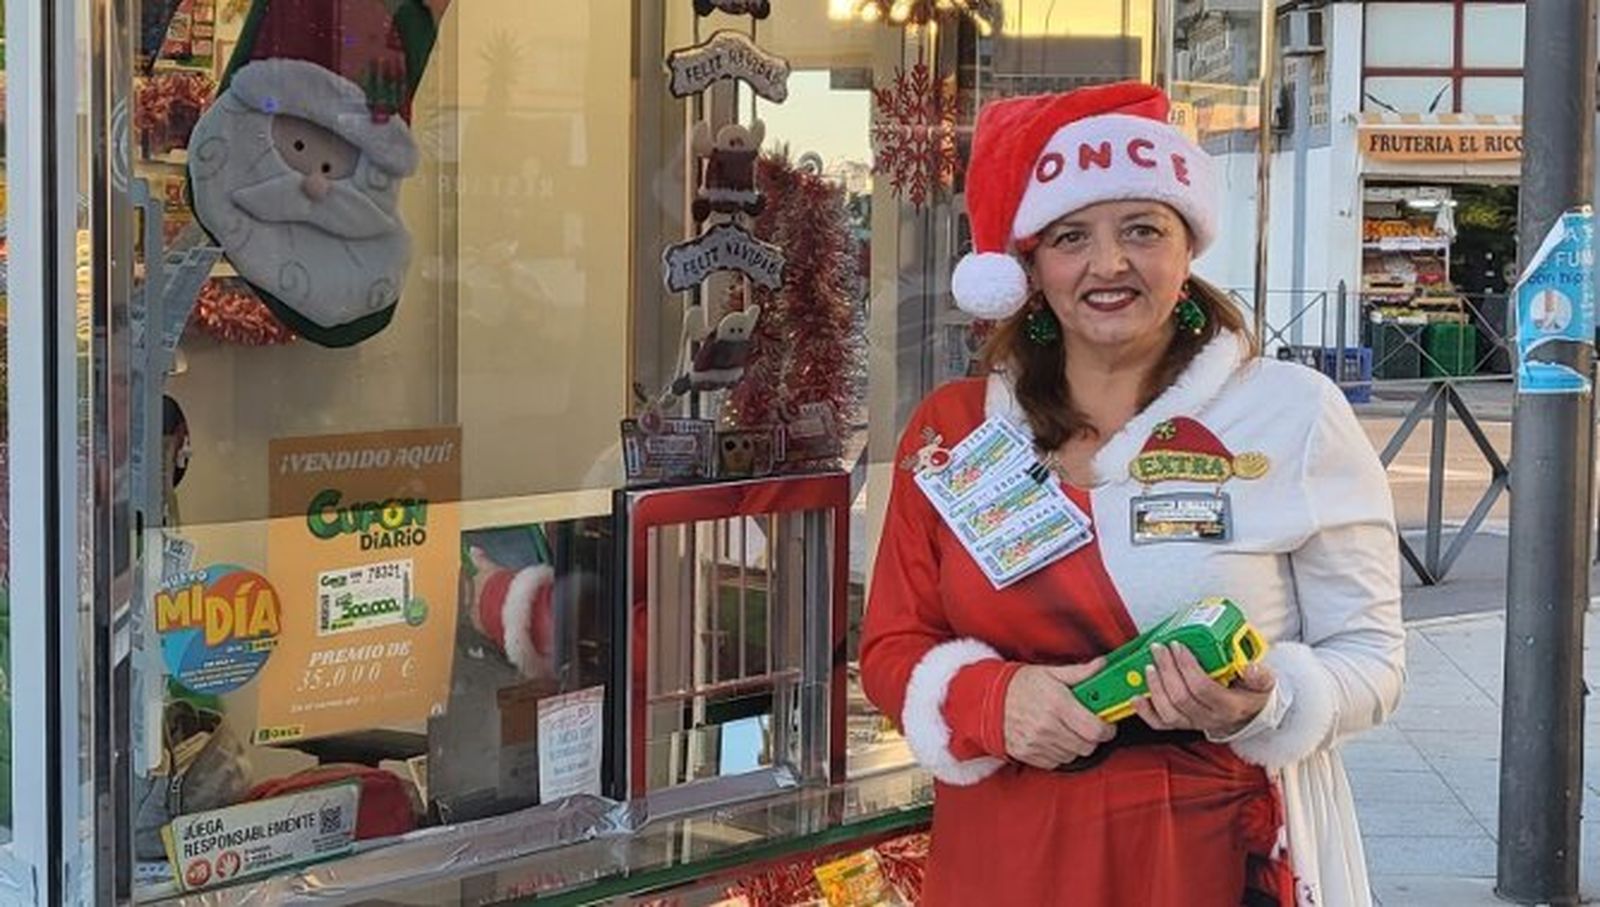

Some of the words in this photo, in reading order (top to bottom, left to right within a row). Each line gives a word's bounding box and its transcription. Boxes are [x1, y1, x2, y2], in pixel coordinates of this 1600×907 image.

[1368, 132, 1454, 153] FRUTERIA
[1458, 134, 1481, 152] EL
[1035, 137, 1191, 188] ONCE
[279, 449, 391, 475] ¡VENDIDO
[394, 440, 454, 470] AQUÍ!
[1138, 454, 1225, 477] EXTRA
[308, 644, 384, 668] PREMIO
[387, 640, 412, 658] DE
[296, 661, 384, 692] 35.000
[183, 818, 224, 841] JUEGA
[183, 811, 316, 859] RESPONSABLEMENTE
